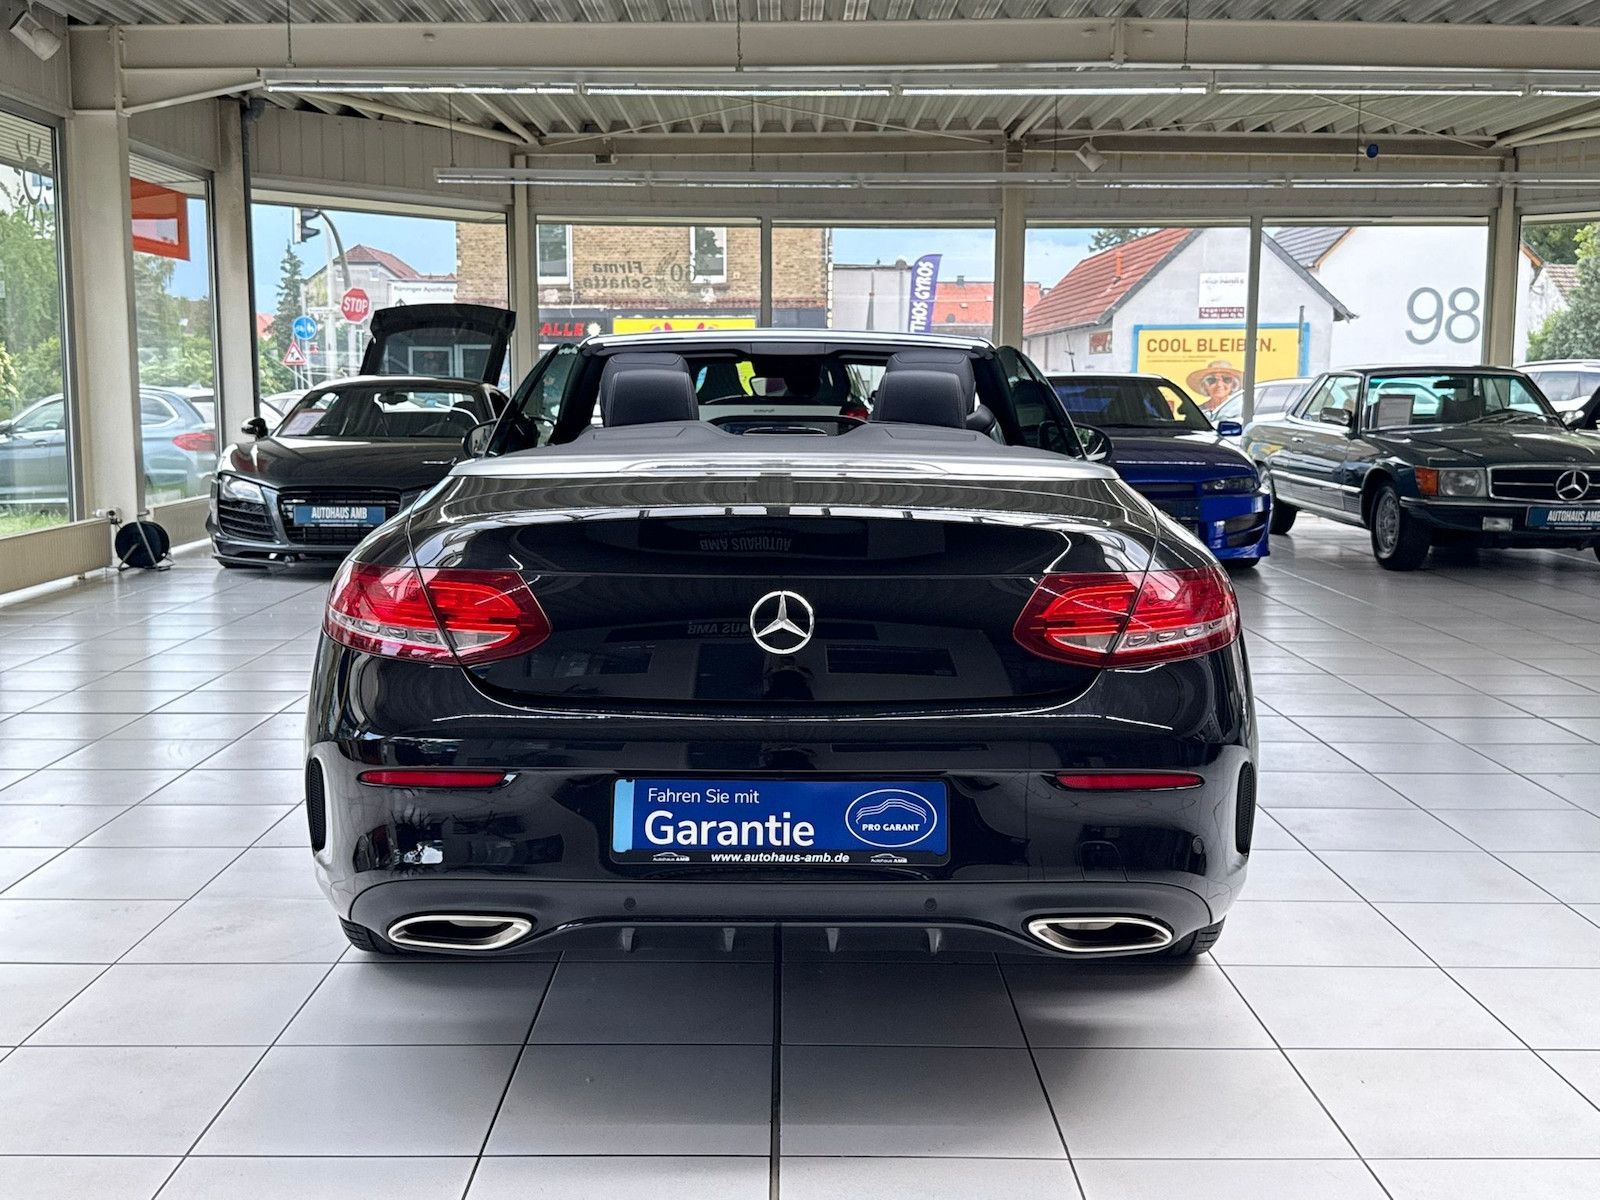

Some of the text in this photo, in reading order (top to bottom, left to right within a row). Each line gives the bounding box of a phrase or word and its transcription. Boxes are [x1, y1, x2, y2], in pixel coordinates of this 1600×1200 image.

[914, 261, 934, 300] GYROS
[343, 296, 369, 313] STOP
[1405, 286, 1481, 345] 98
[1147, 337, 1277, 353] COOL BLEIBN.
[312, 506, 368, 519] AUTOHAUS AMB
[1546, 510, 1586, 522] AUTOHAUS
[647, 787, 760, 804] Fahren Sie mit
[644, 810, 815, 847] Garantie
[861, 823, 920, 832] PRO GARANT
[710, 852, 850, 864] www.autohaus-amb.de
